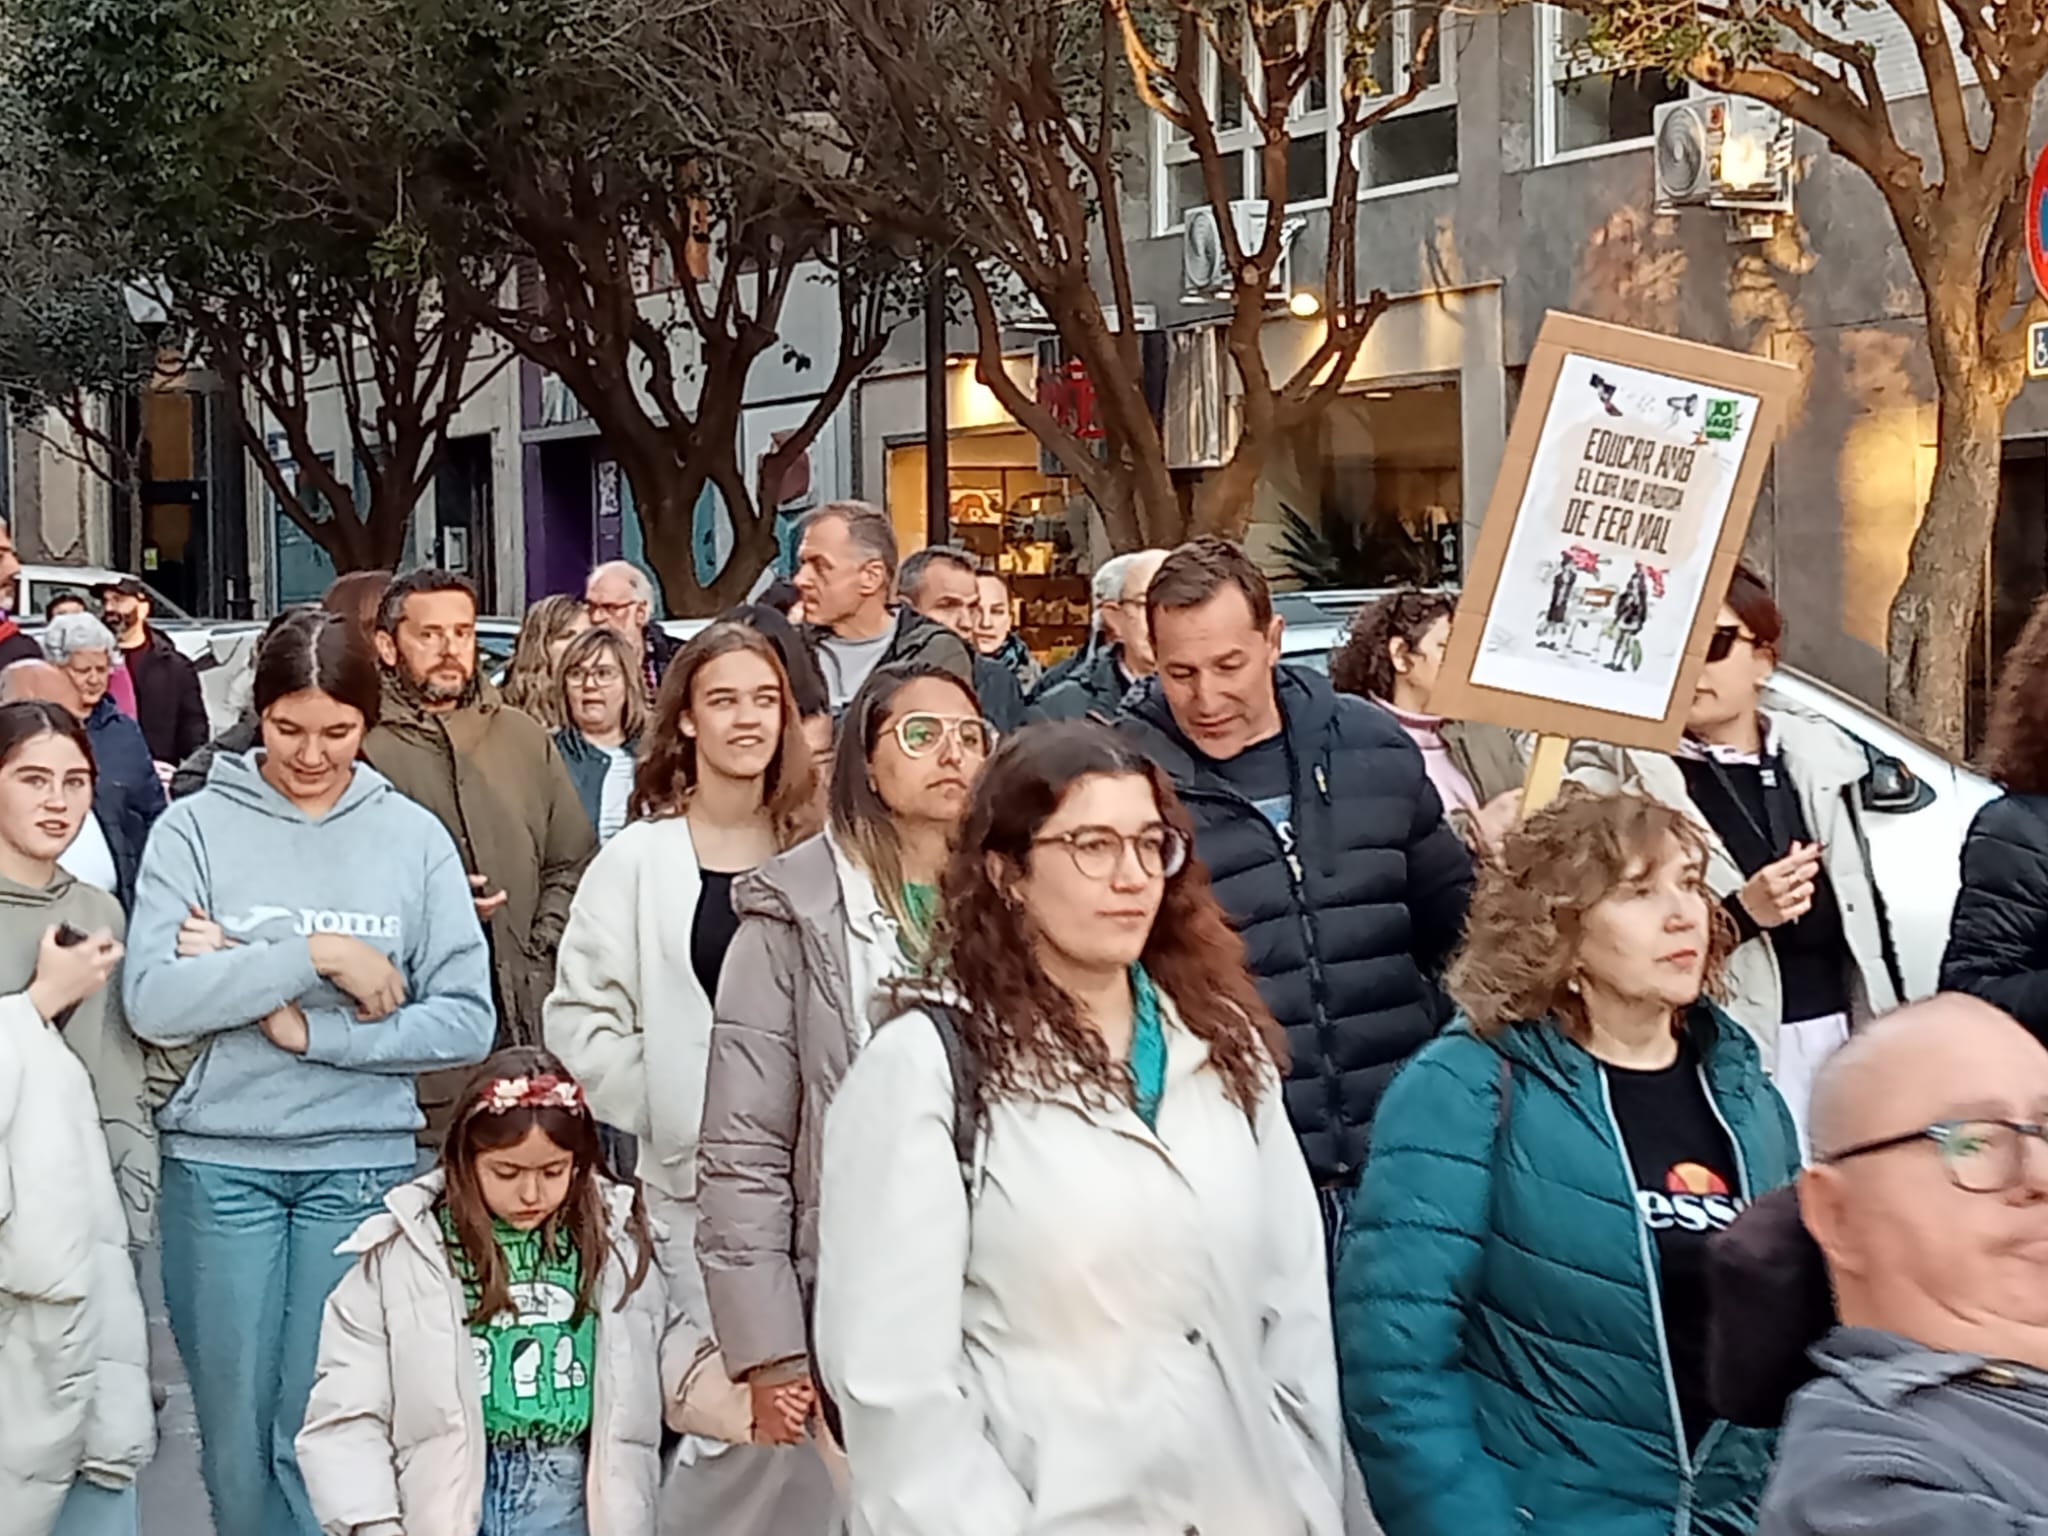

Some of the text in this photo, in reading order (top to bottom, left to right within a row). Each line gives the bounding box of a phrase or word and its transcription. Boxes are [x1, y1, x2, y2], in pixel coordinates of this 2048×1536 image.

[1583, 427, 1695, 483] EDUCAR AMB
[1574, 467, 1592, 493] EL
[1560, 497, 1672, 555] DE FER MAL
[1635, 1190, 1746, 1231] ess
